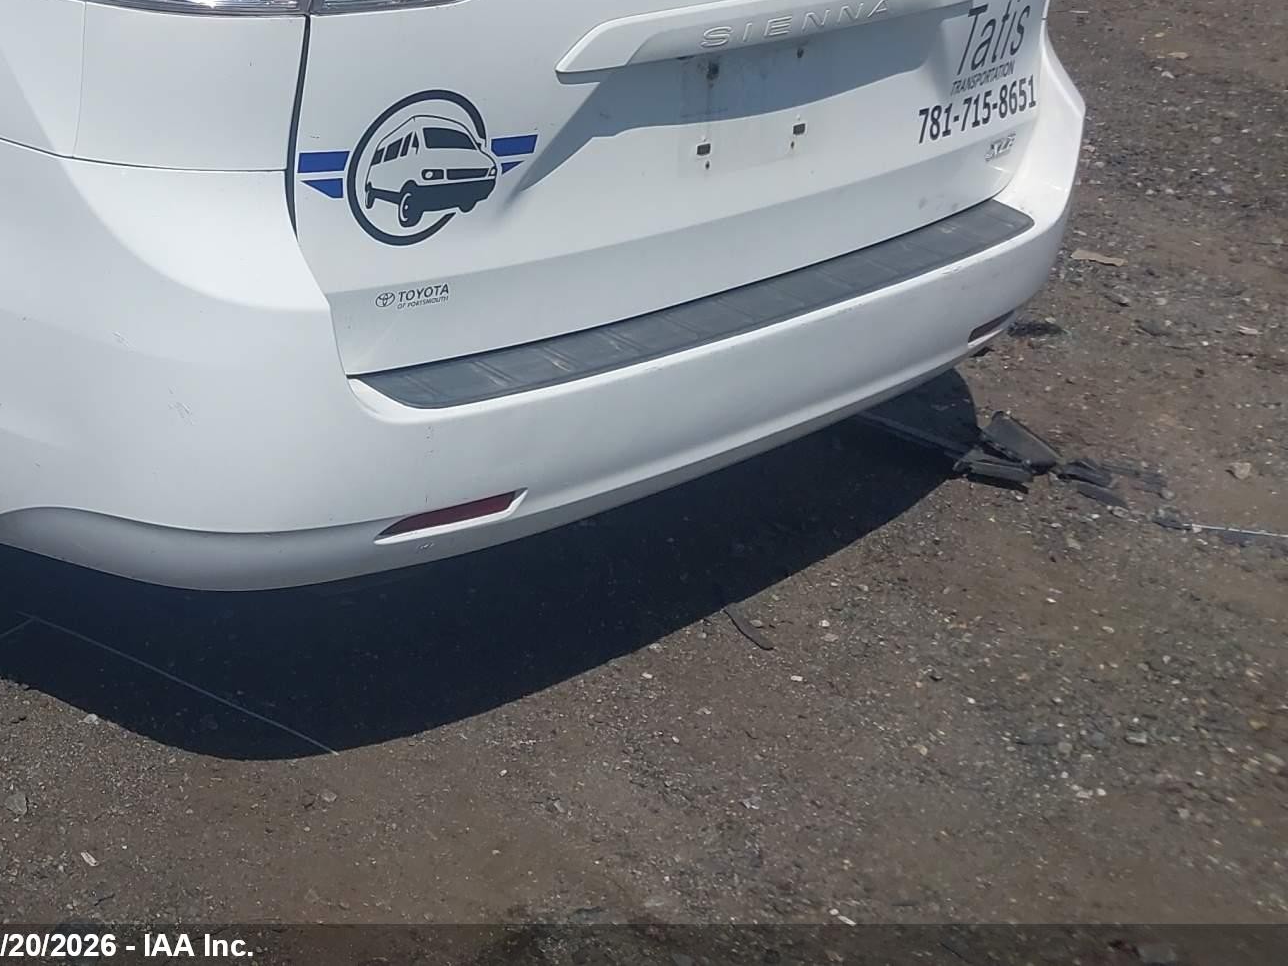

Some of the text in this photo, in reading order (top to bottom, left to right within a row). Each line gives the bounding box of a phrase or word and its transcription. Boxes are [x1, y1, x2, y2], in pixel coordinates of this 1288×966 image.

[950, 60, 1015, 96] TRANSPORTATION
[919, 74, 1037, 144] 781-715-8651
[398, 283, 449, 303] TOYOTA
